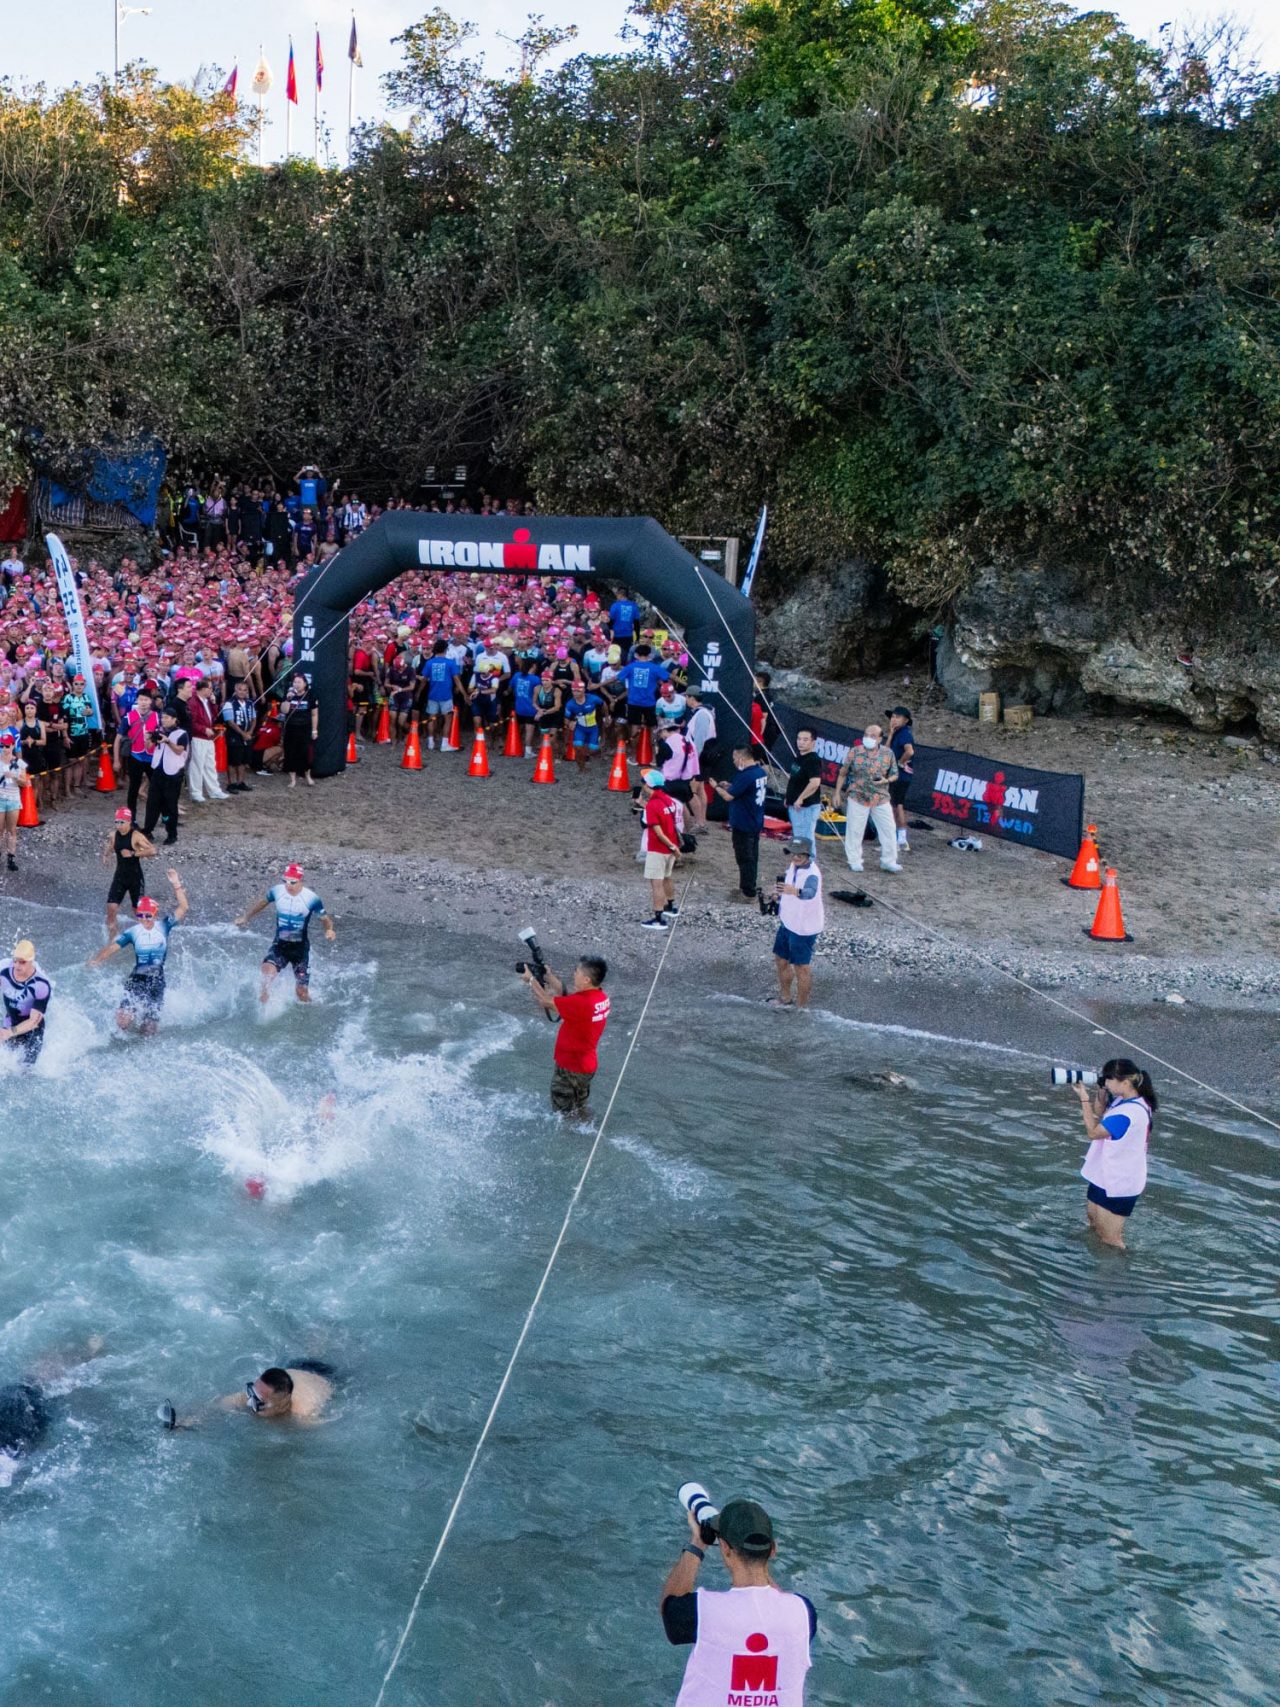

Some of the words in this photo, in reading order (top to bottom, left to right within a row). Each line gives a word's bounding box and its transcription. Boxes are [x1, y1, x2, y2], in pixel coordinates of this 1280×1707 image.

[418, 529, 595, 572] IRONMAN
[301, 615, 316, 662] SWIM
[701, 641, 722, 693] SWIM
[934, 769, 1039, 814] IRONMAN
[727, 1693, 779, 1707] MEDIA
